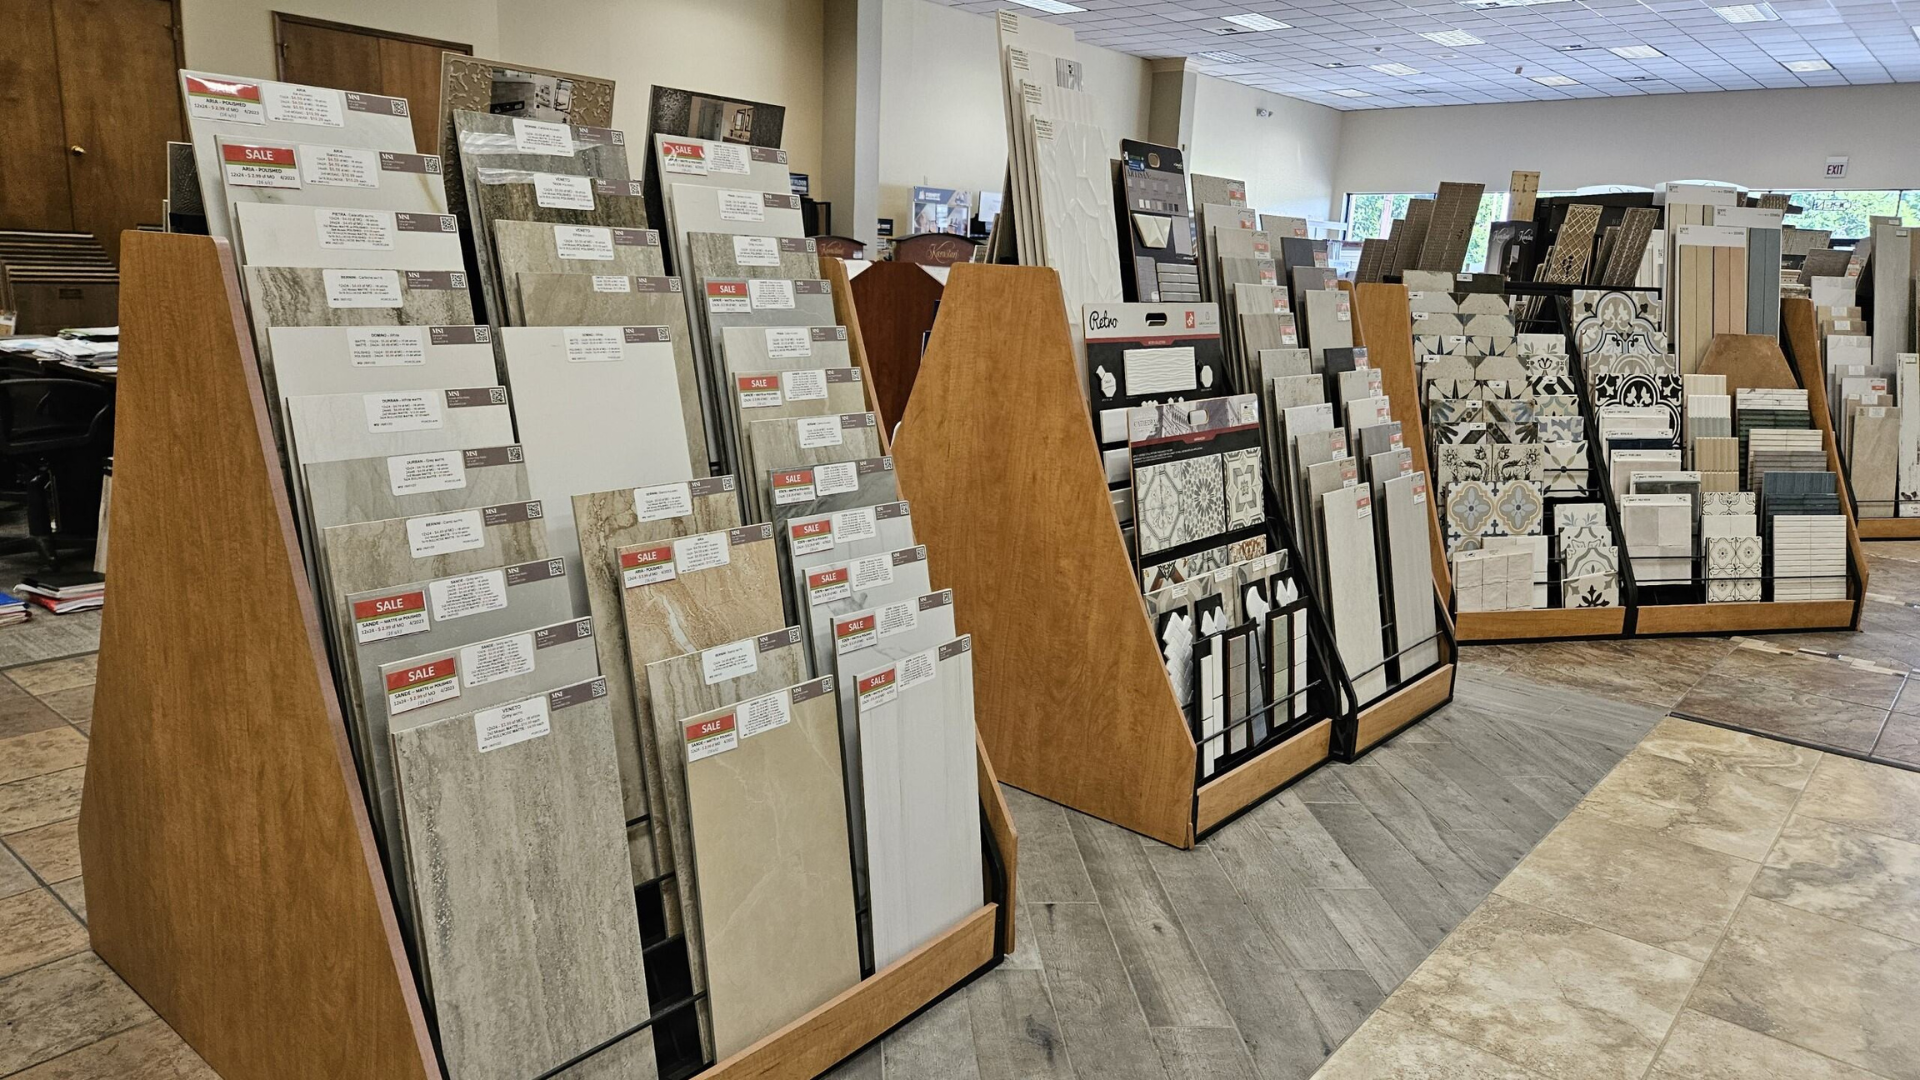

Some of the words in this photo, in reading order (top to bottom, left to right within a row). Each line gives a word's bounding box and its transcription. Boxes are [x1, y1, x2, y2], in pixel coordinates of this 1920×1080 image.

[245, 149, 274, 160] SALE
[675, 145, 692, 155] SALE
[1827, 165, 1844, 175] EXIT
[720, 285, 736, 293] SALE
[1089, 310, 1118, 331] Retro
[751, 379, 767, 387] SALE
[785, 475, 801, 483] SALE
[804, 524, 819, 533] SALE
[637, 551, 657, 562] SALE
[821, 572, 837, 582] SALE
[376, 598, 404, 612] SALE
[848, 621, 864, 631] SALE
[408, 666, 435, 682] SALE
[871, 675, 885, 686] SALE
[394, 691, 411, 699] SANDE
[502, 705, 521, 713] VENETO
[702, 720, 720, 733] SALE
